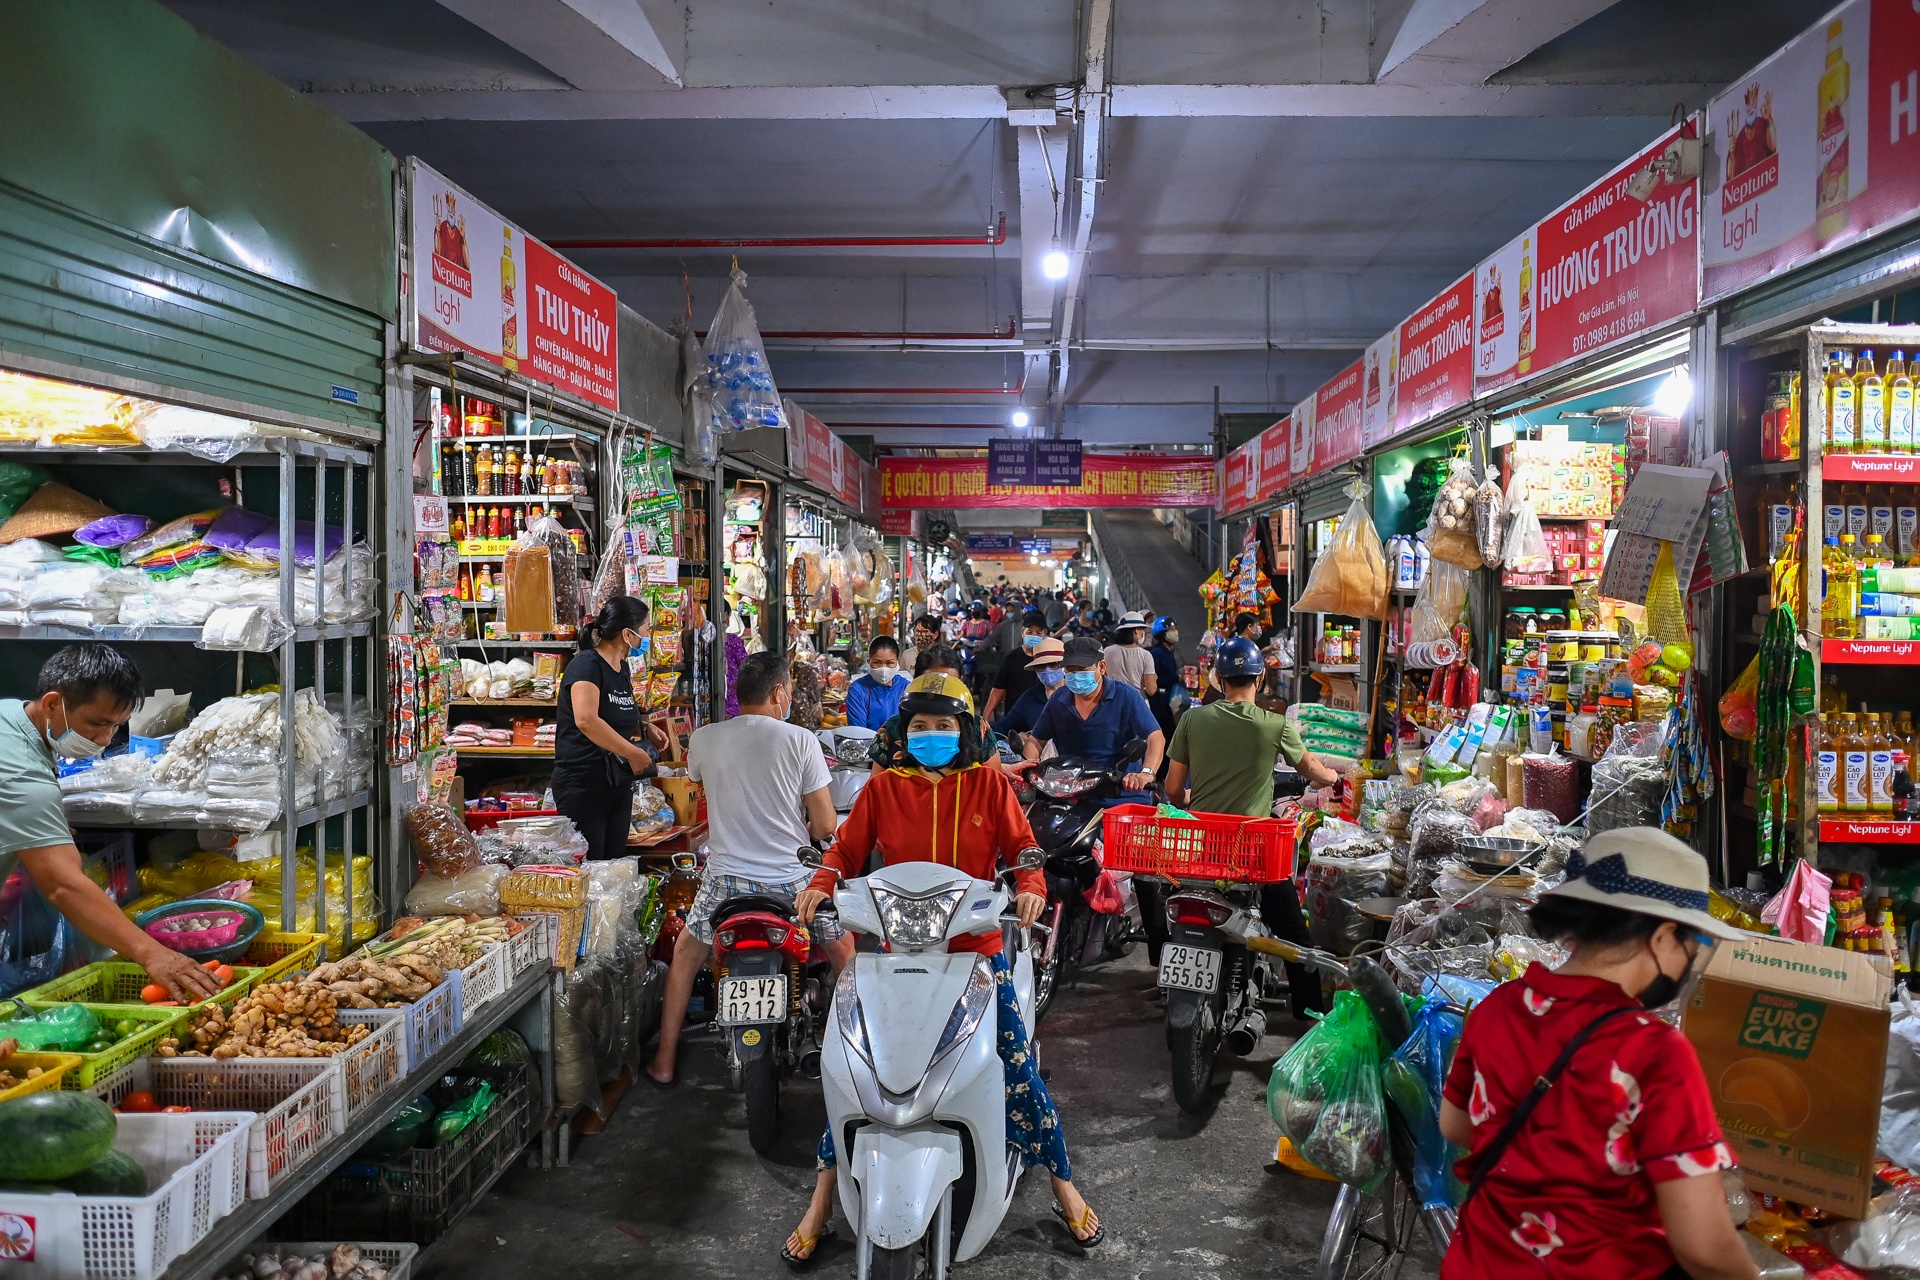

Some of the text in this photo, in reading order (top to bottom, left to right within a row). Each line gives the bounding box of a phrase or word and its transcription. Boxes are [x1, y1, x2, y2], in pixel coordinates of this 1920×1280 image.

[1723, 165, 1776, 208] Neptune
[1563, 208, 1583, 234] CỬA
[1584, 189, 1613, 220] HÀNG
[1723, 202, 1760, 252] Light
[1540, 186, 1693, 312] HƯƠNG TRƯỜNG
[433, 260, 471, 293] Neptune
[558, 263, 591, 296] CỬA HÀNG
[434, 285, 461, 326] Light
[535, 284, 610, 357] THU THỦY
[1578, 308, 1590, 325] Chợ
[1591, 304, 1601, 318] Gia
[1617, 291, 1626, 306] Hà
[1627, 286, 1639, 304] Nội
[443, 341, 449, 352] 10
[1480, 319, 1504, 341] Neptune
[1573, 309, 1646, 354] ĐT: 0989 418 694
[535, 335, 561, 358] CHUYÊN
[561, 347, 574, 365] BÁN
[575, 351, 592, 371] BUÔN
[1400, 342, 1430, 384] HƯƠNG
[1431, 315, 1471, 363] TRƯỜNG
[1480, 342, 1497, 371] Light
[533, 355, 552, 375] HÀNG
[552, 361, 566, 381] KHÔ
[592, 379, 602, 396] CÁC
[894, 463, 931, 499] QUYỀN
[933, 470, 950, 502] LỢI
[952, 465, 987, 496] NGƯỜI
[1102, 465, 1138, 500] NHIỆM
[1851, 460, 1914, 473] Neptune Light
[1850, 643, 1913, 655] Neptune Light
[1848, 824, 1912, 836] Neptune Light
[1169, 946, 1212, 970] 29-C1
[729, 979, 776, 1000] 29-V2
[1161, 965, 1214, 991] 555.63
[729, 1000, 776, 1020] 0212
[1749, 1005, 1818, 1032] EURO
[1743, 1025, 1814, 1052] CAKE
[1718, 1114, 1767, 1136] ustard
